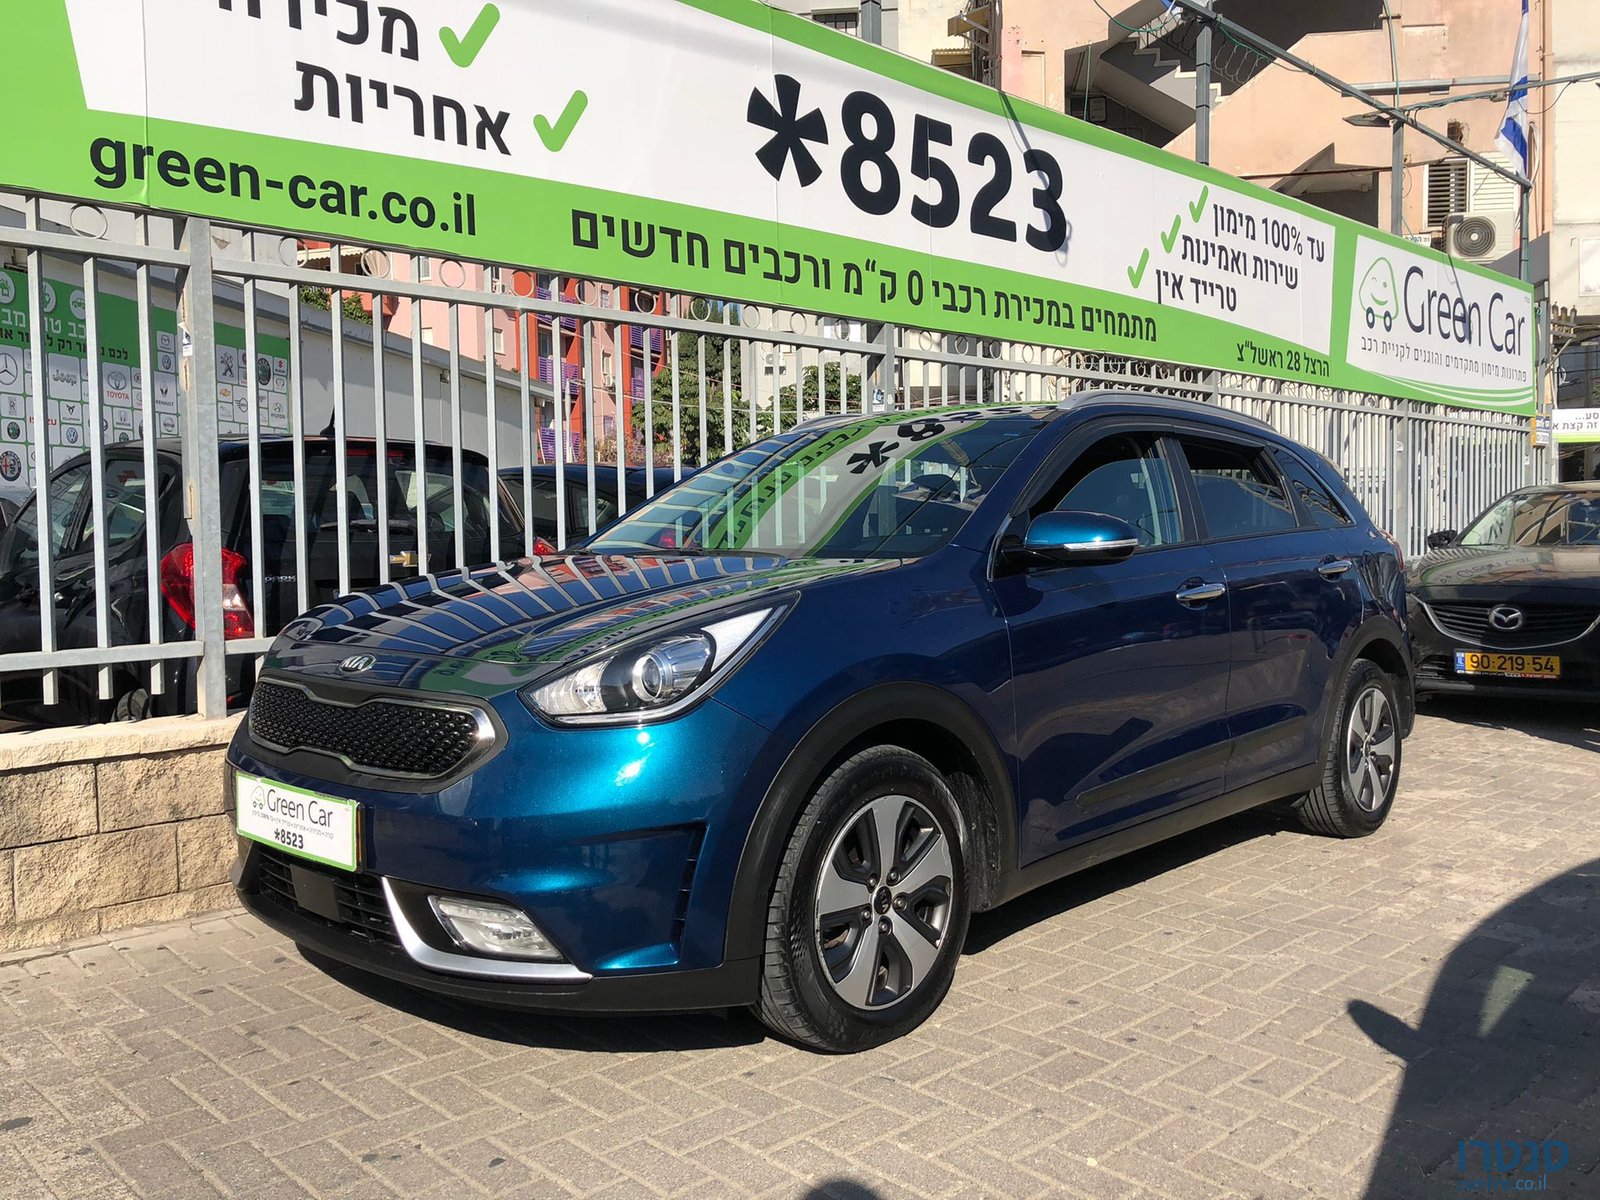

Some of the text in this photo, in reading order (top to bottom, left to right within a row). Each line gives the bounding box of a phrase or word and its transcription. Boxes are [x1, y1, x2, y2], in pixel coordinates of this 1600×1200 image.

[294, 61, 511, 156] אחריות
[89, 134, 476, 237] green-car.co.il
[571, 208, 710, 269] חדשים
[1213, 202, 1325, 263] עד 100% מימון
[723, 238, 831, 290] ורכבים
[1182, 234, 1298, 290] שירות ואמינות
[908, 269, 924, 306] 0
[932, 280, 986, 317] רכבי
[1156, 268, 1237, 312] טרייד אין
[994, 291, 1075, 330] במכירת
[1082, 306, 1157, 342] מתמחים
[1404, 266, 1525, 357] Green Car
[58, 338, 72, 351] רק
[108, 348, 128, 360] לכם
[1286, 350, 1301, 372] 28
[1361, 336, 1527, 382] פתרונות מימון מתקדמים והוגנים לקניית רכב
[1303, 351, 1330, 377] הרצל
[106, 390, 130, 400] TOYOTA
[155, 399, 174, 407] RENAULT
[1562, 421, 1584, 432] קצת
[1586, 421, 1598, 430] זה
[264, 575, 296, 584] PARK
[340, 655, 370, 671] KIA
[267, 788, 333, 828] Green Car
